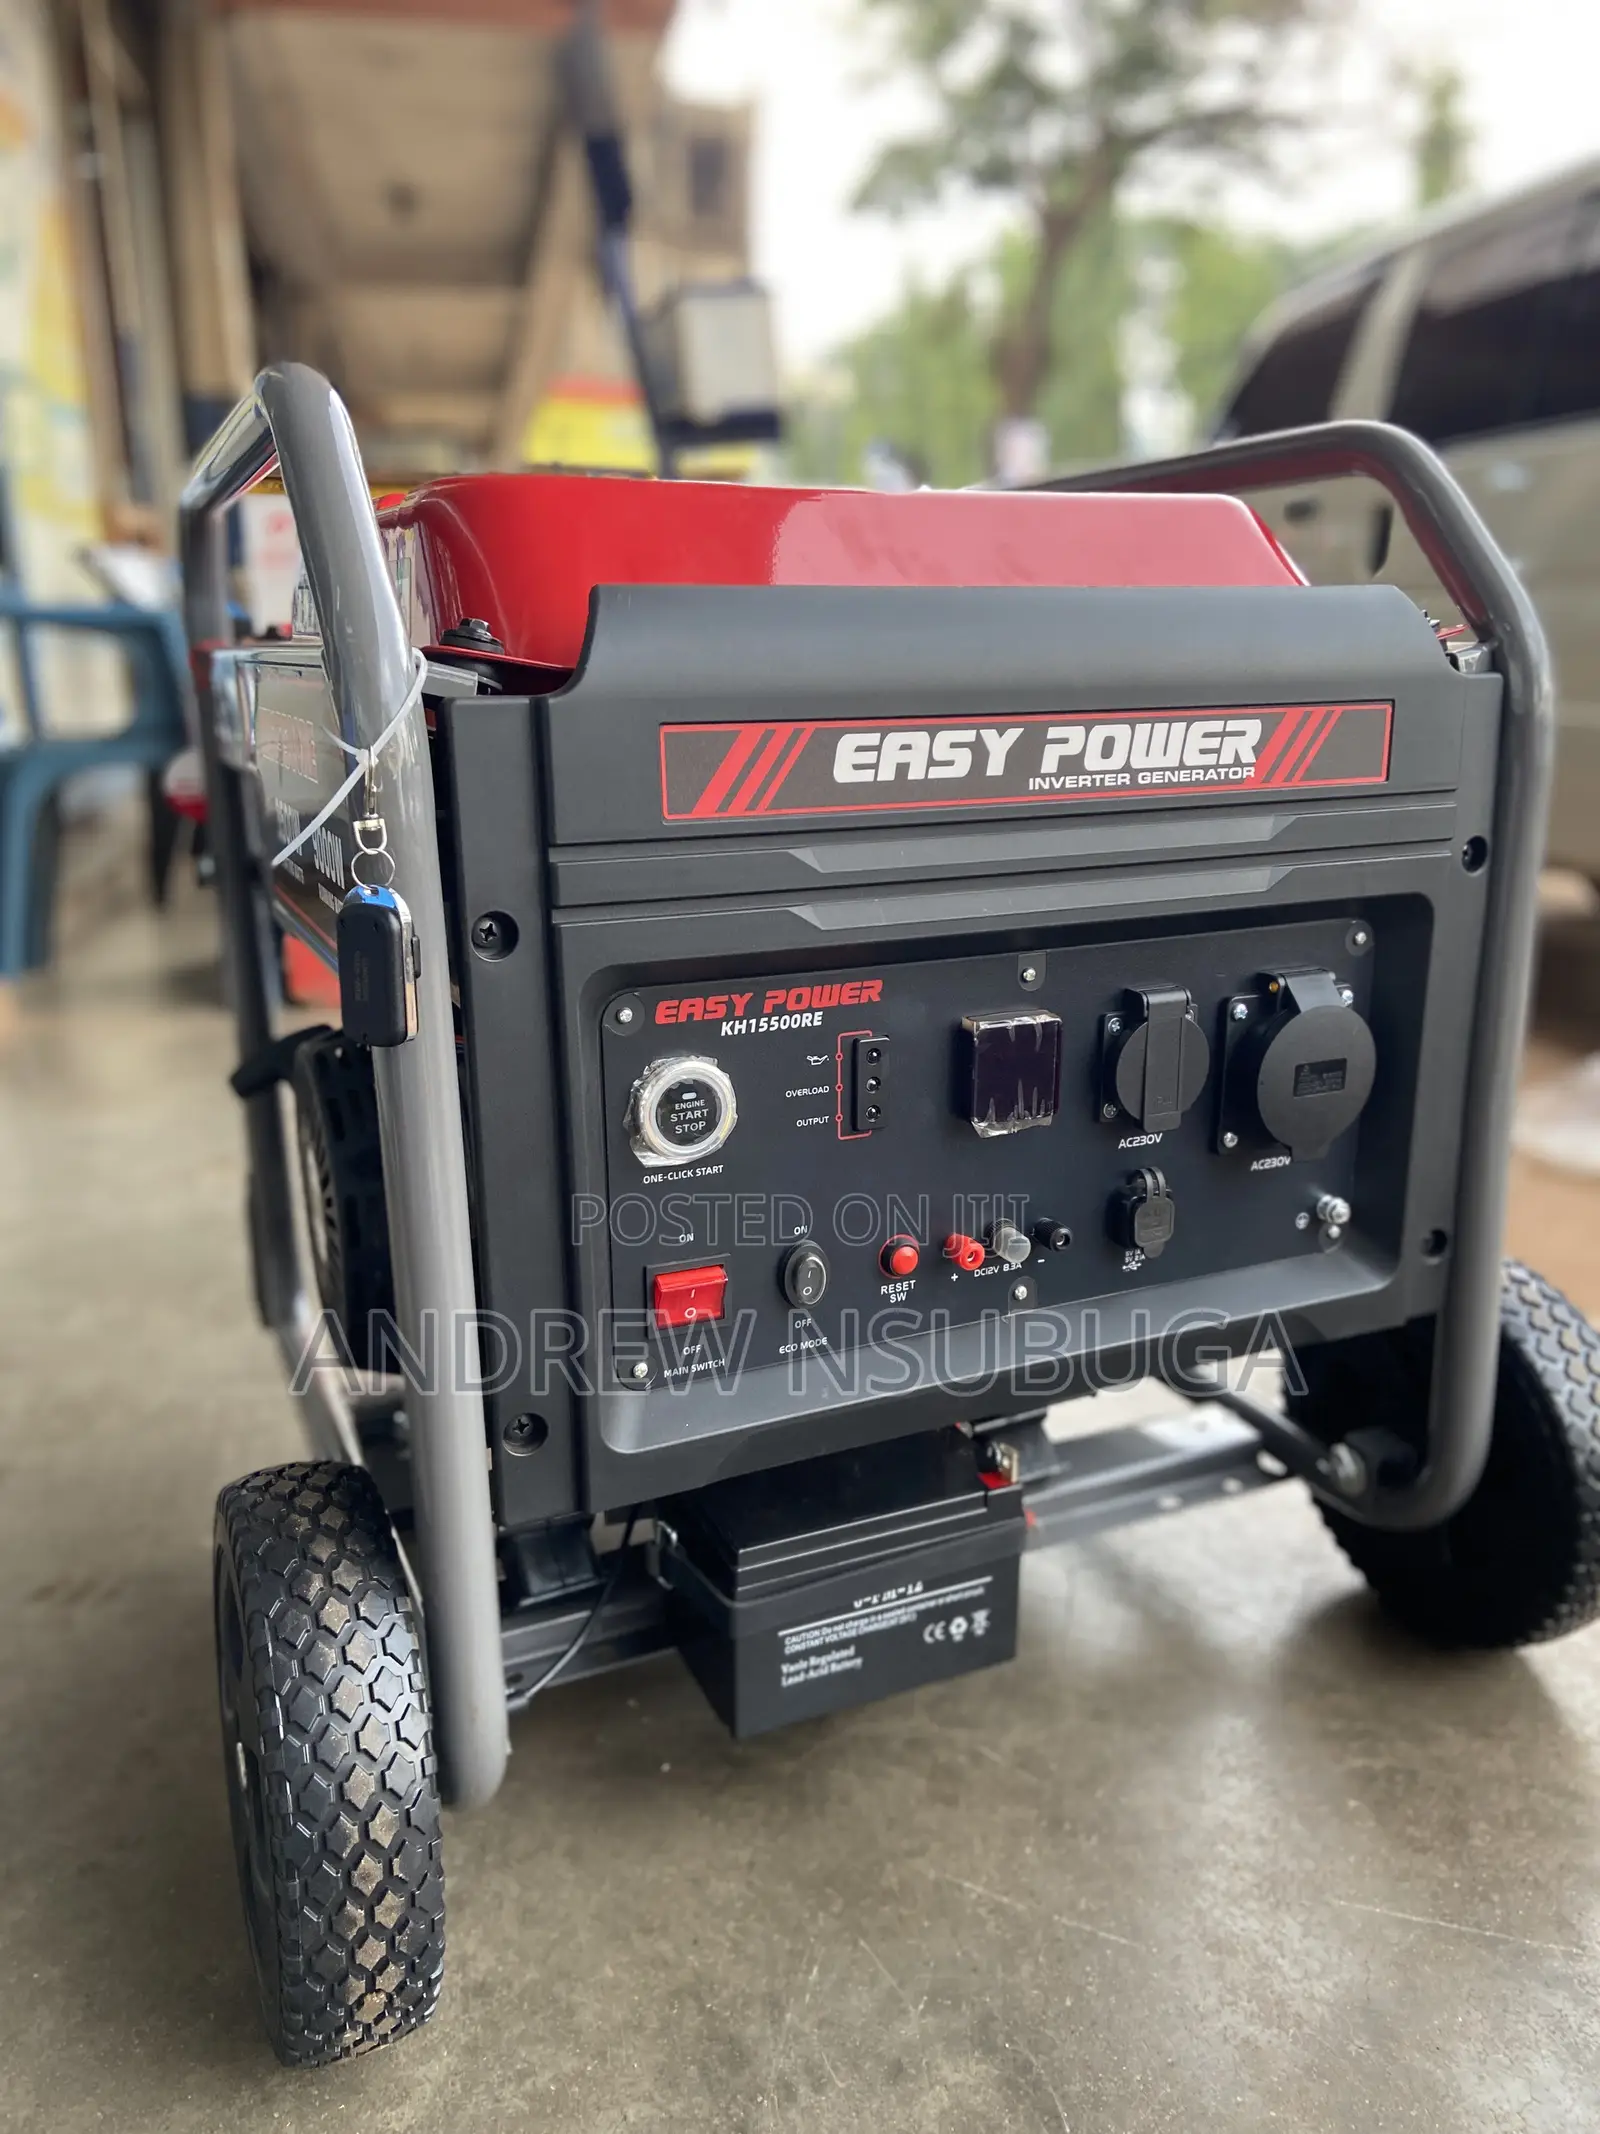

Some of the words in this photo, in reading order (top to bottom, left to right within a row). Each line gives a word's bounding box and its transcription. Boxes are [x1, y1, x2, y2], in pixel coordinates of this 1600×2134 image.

[833, 727, 1024, 784] EASY
[1040, 717, 1265, 775] POWER
[1028, 772, 1131, 791] INVERTER
[1137, 766, 1256, 786] GENERATOR
[655, 993, 753, 1025] EASY
[763, 979, 884, 1013] POWER
[720, 1011, 824, 1037] KH15500RE
[785, 1084, 830, 1099] OVERLOAD
[675, 1098, 706, 1111] ENGINE
[670, 1108, 709, 1123] START
[796, 1114, 830, 1128] OUTPUT
[675, 1120, 707, 1135] STOP
[1118, 1133, 1163, 1150] AC230V
[1250, 1155, 1291, 1172] AC230V
[643, 1168, 694, 1184] ONE-CLICK
[695, 1164, 724, 1178] START
[794, 1224, 808, 1236] ON
[679, 1232, 694, 1244] ON
[974, 1265, 999, 1277] DC12V
[1003, 1262, 1022, 1272] 8.3A
[880, 1280, 917, 1295] RESET
[889, 1292, 907, 1303] SW
[795, 1318, 812, 1329] OFF
[683, 1345, 702, 1355] OFF
[779, 1342, 799, 1355] ECO
[800, 1337, 828, 1350] MODE
[664, 1364, 689, 1378] MAIN
[691, 1358, 725, 1373] SWITCH
[923, 1620, 947, 1643] CE
